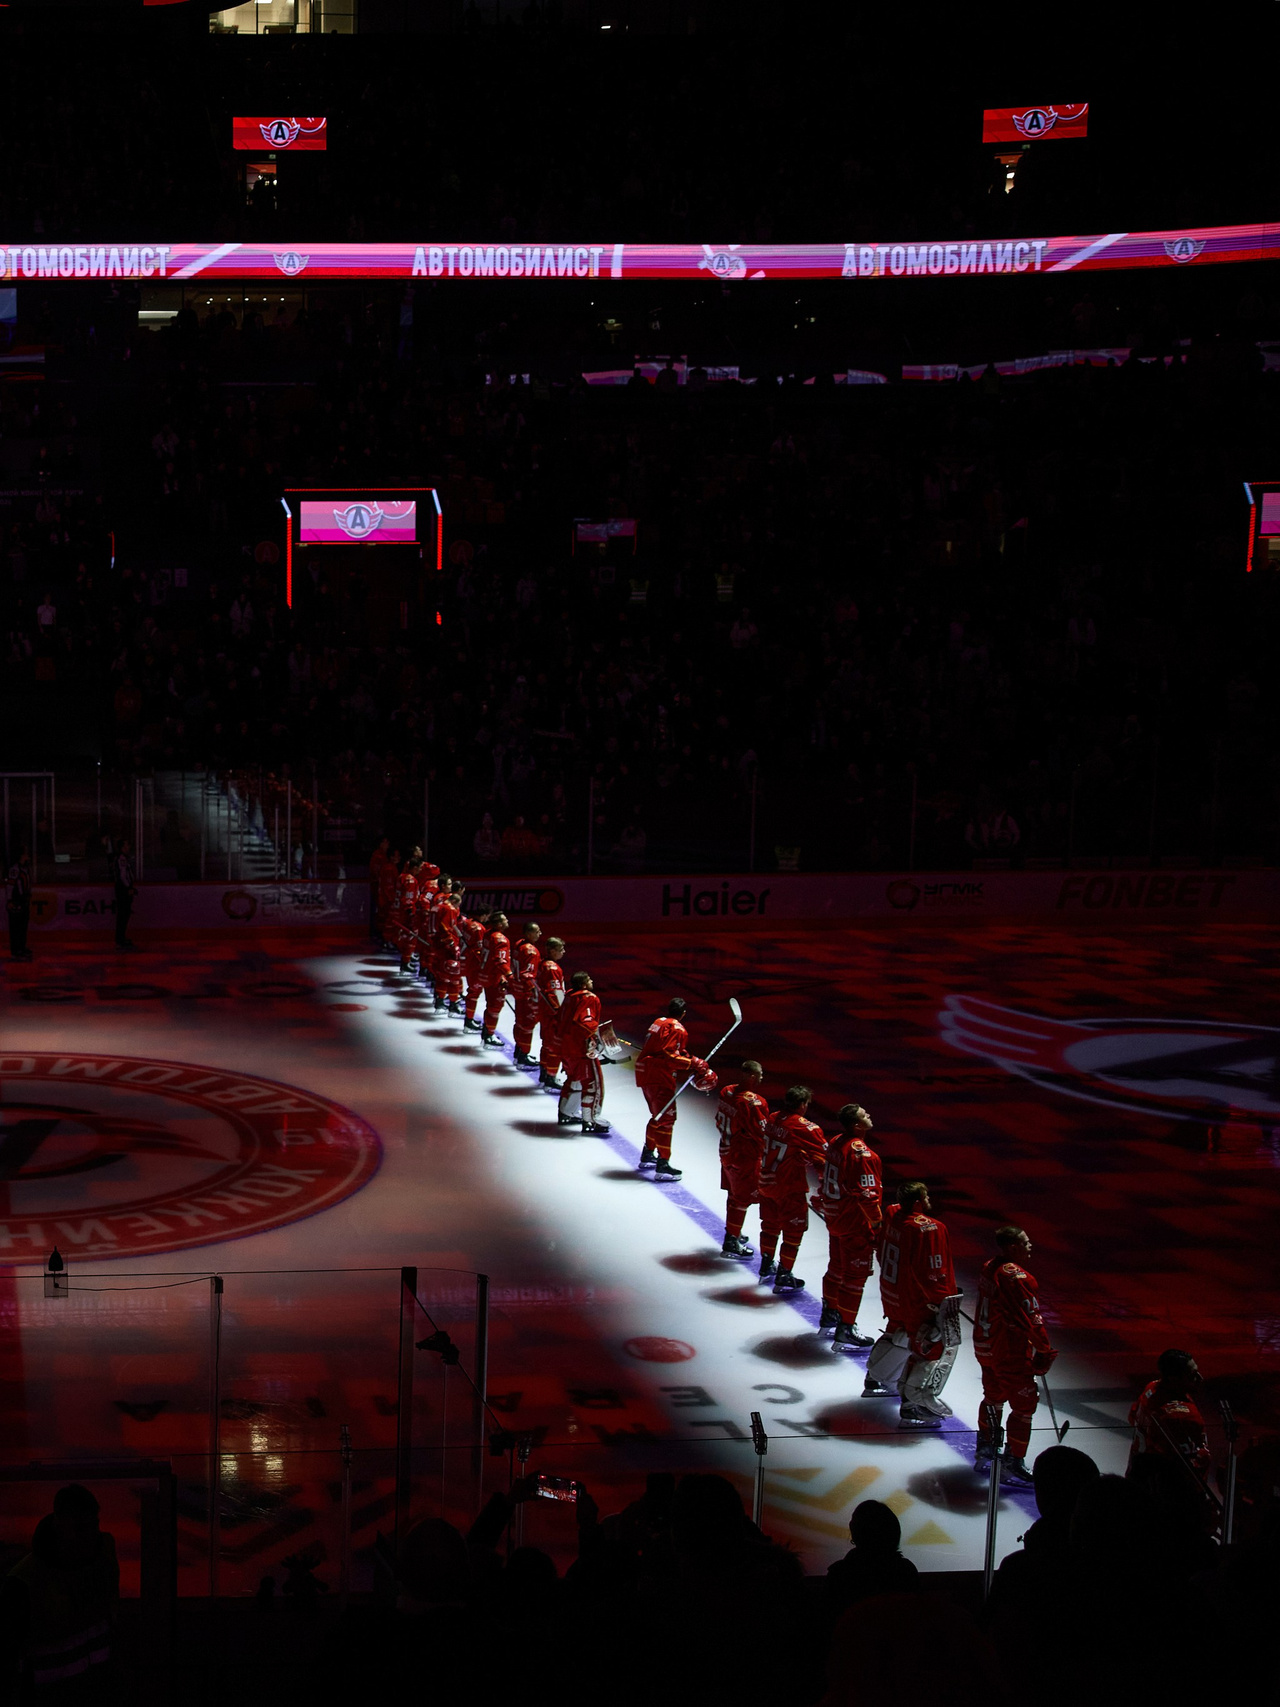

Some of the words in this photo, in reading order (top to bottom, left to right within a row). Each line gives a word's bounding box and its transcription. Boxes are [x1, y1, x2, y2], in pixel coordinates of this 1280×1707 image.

[412, 246, 604, 277] АВТОМОБИЛИСТ
[841, 241, 1047, 277] АВТОМОБИЛИСТ
[662, 882, 770, 917] Haier
[924, 882, 984, 895] УГМК
[1055, 876, 1237, 909] FONBET
[65, 900, 117, 915] БАН
[860, 1174, 875, 1187] 88
[928, 1254, 942, 1269] 18
[977, 1294, 992, 1340] 4
[1023, 1296, 1040, 1317] 24
